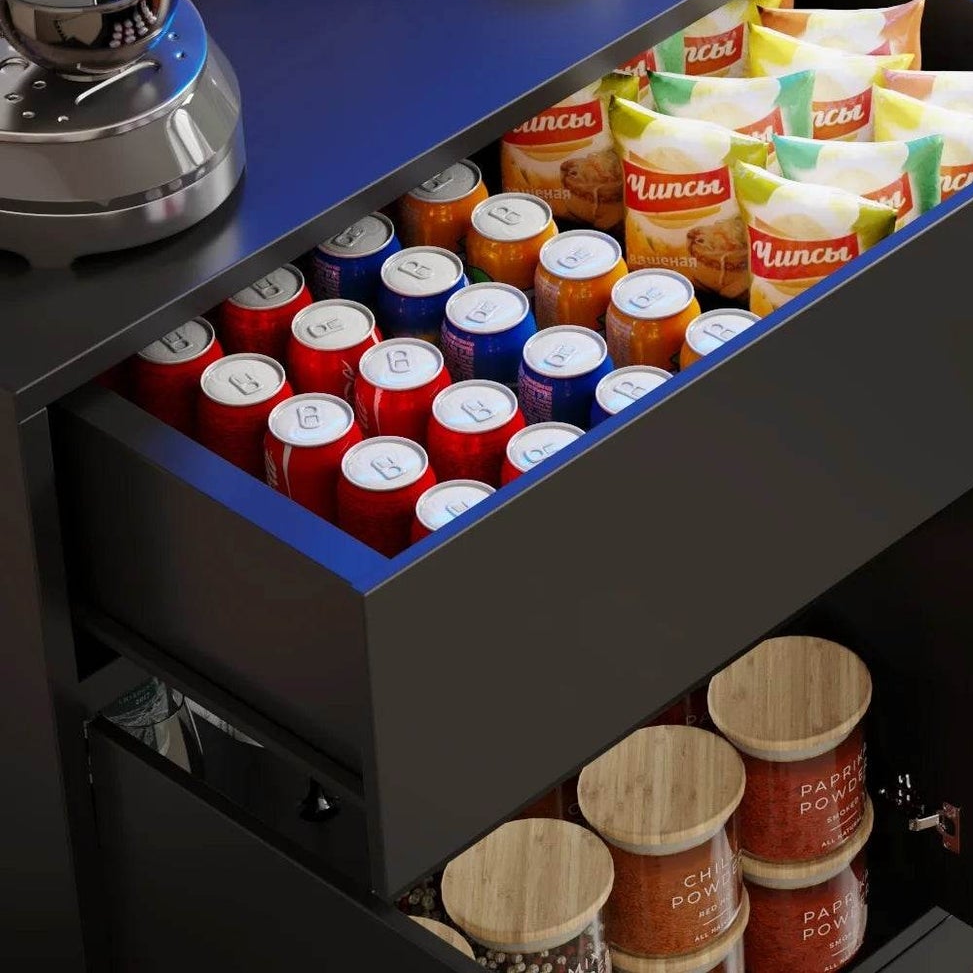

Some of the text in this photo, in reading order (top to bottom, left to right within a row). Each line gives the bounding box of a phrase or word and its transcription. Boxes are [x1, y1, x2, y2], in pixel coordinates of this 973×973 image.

[626, 173, 725, 201] Чипсы
[752, 240, 853, 269] Чипсы
[800, 760, 867, 815] POWDE
